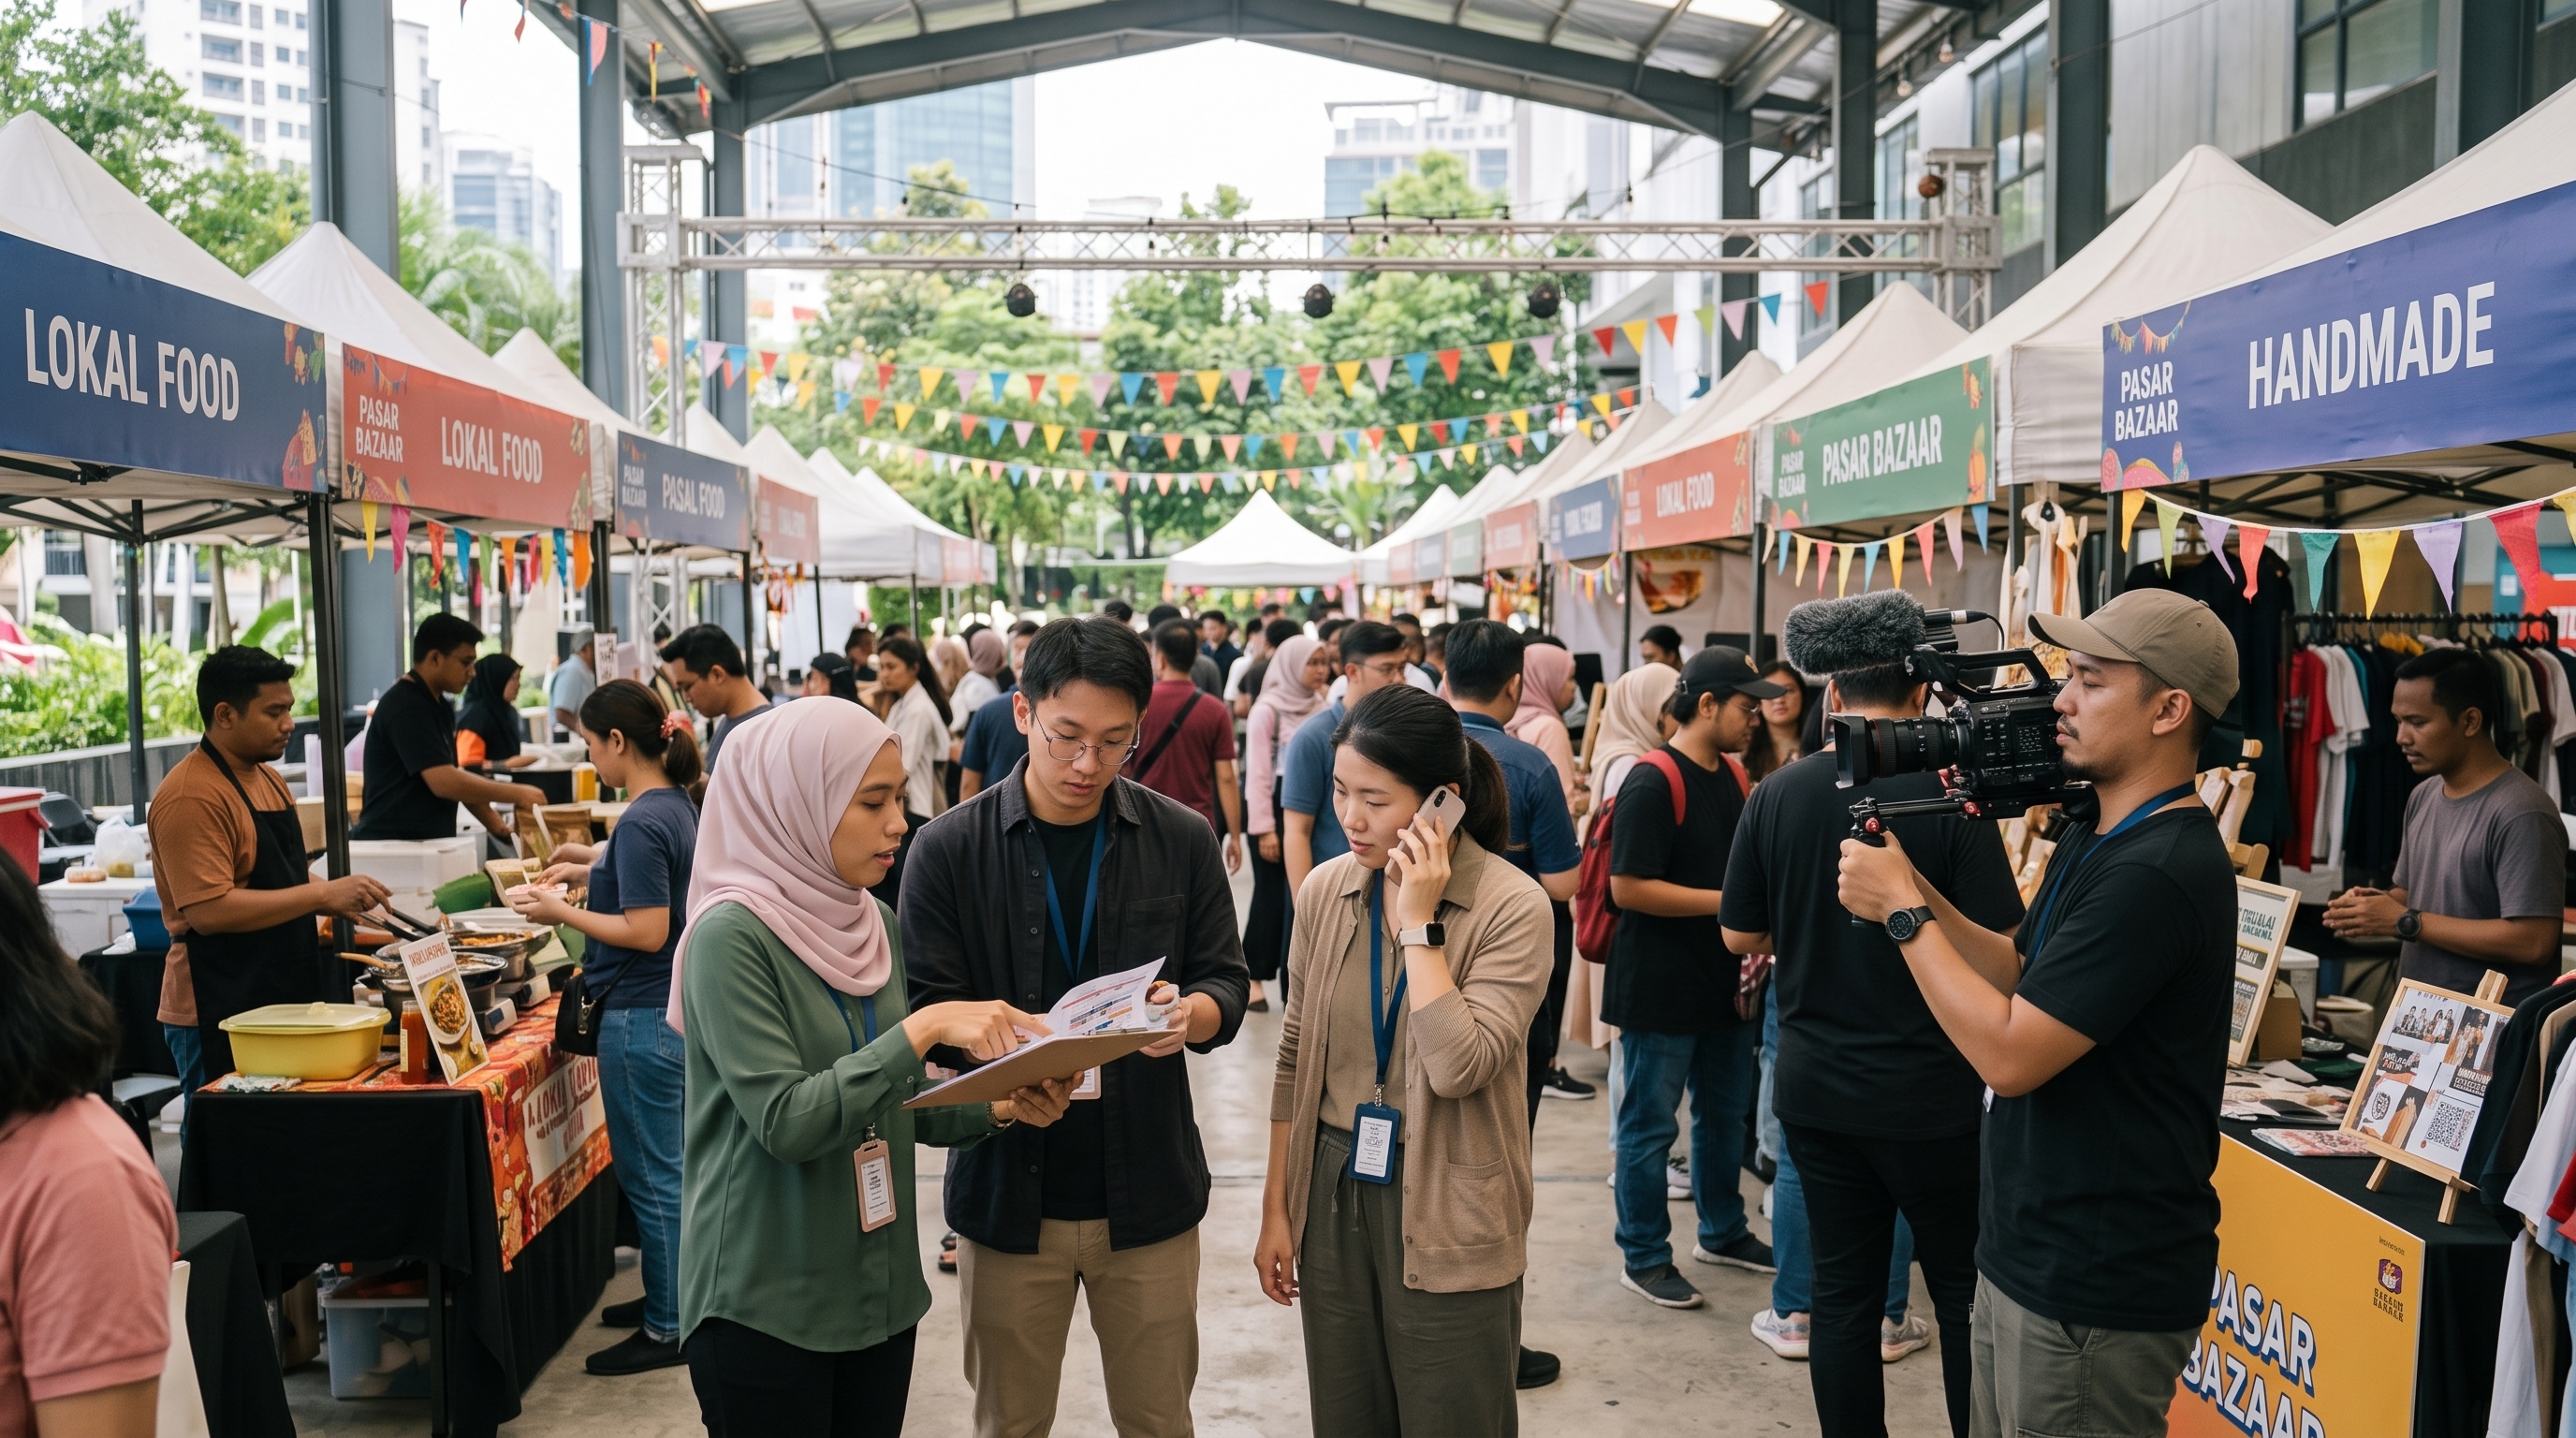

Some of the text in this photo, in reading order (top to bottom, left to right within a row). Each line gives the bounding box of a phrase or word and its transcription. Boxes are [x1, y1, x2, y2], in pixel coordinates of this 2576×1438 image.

[25, 308, 240, 421] LOKAL FOOD
[2248, 281, 2496, 409] HANDMADE
[2121, 361, 2174, 404] PASAR
[359, 394, 399, 432] PASAR
[2115, 399, 2179, 442] BAZAAR
[356, 426, 403, 463] BAZAAR
[441, 417, 543, 484] LOKAL FOOD
[1781, 450, 1805, 475] PASAR
[1822, 414, 1943, 487] PASAR BAZAAR
[622, 485, 647, 509] BAZAAR
[623, 464, 645, 487] PASAR
[662, 473, 698, 516] PASAL
[699, 482, 726, 521] FOOD
[1655, 479, 1685, 519] LOKAL
[1686, 471, 1716, 512] FOOD
[1778, 472, 1807, 499] BAZAAR
